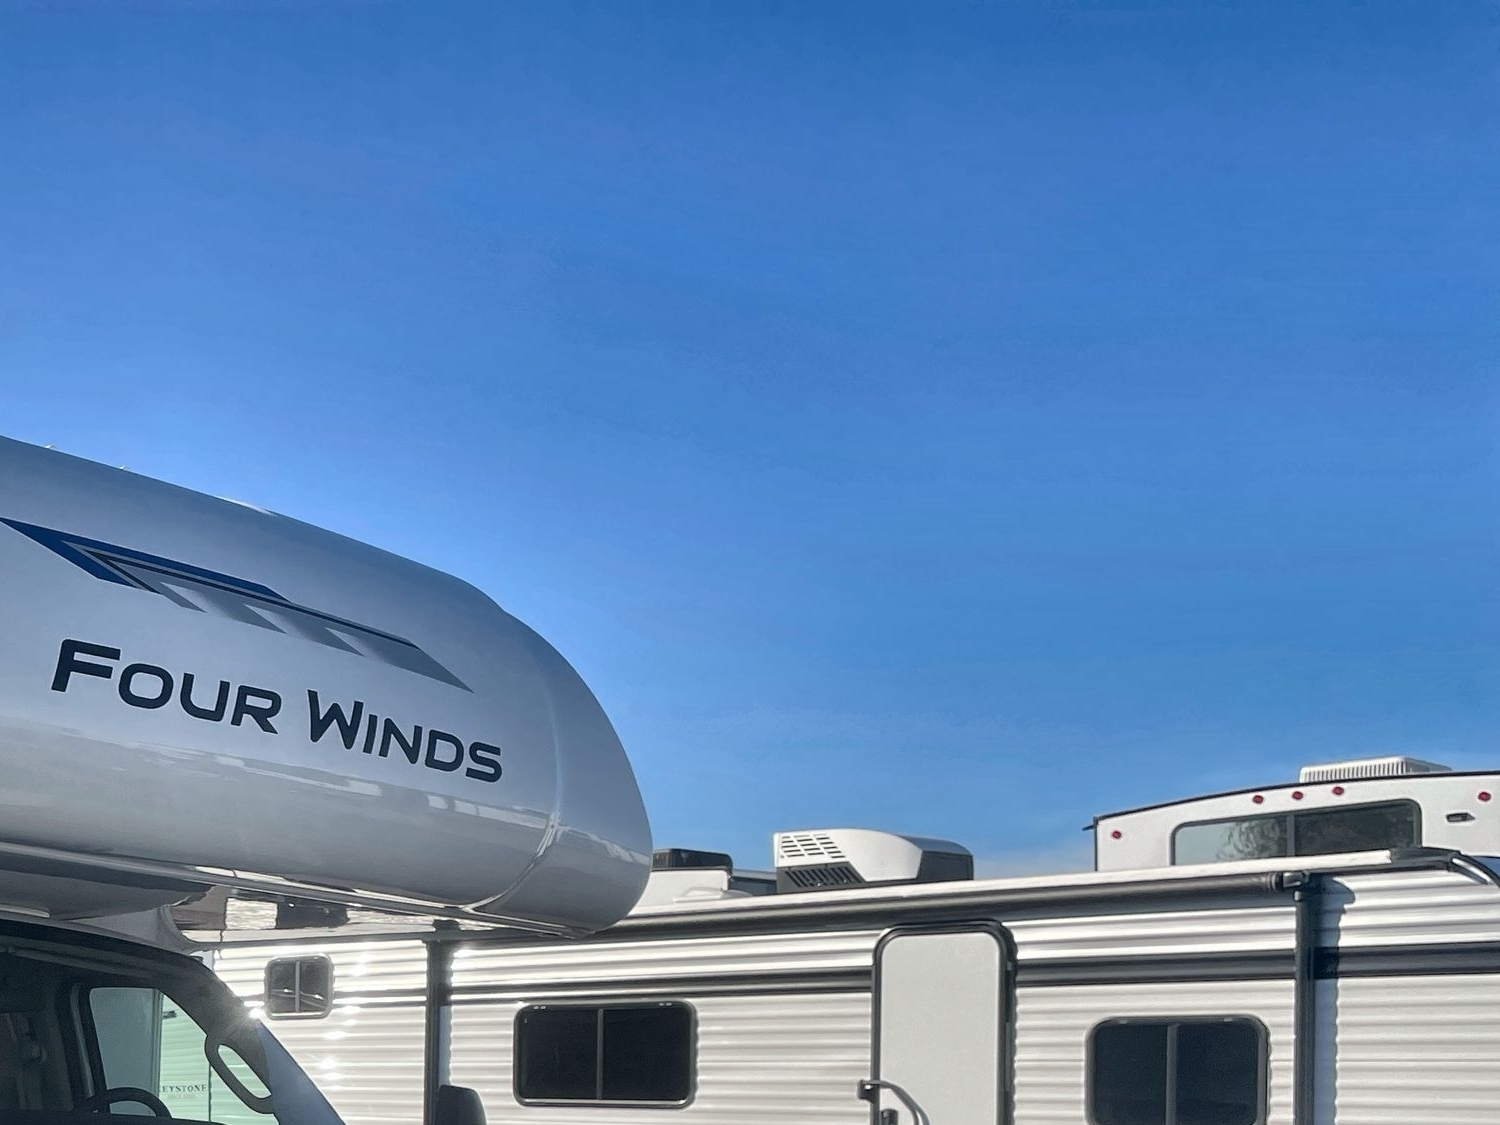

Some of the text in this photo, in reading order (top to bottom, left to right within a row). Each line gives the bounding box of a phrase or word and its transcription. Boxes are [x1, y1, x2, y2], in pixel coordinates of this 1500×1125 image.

[50, 638, 503, 784] FOUR WINDS
[159, 1084, 207, 1093] EYSTONE
